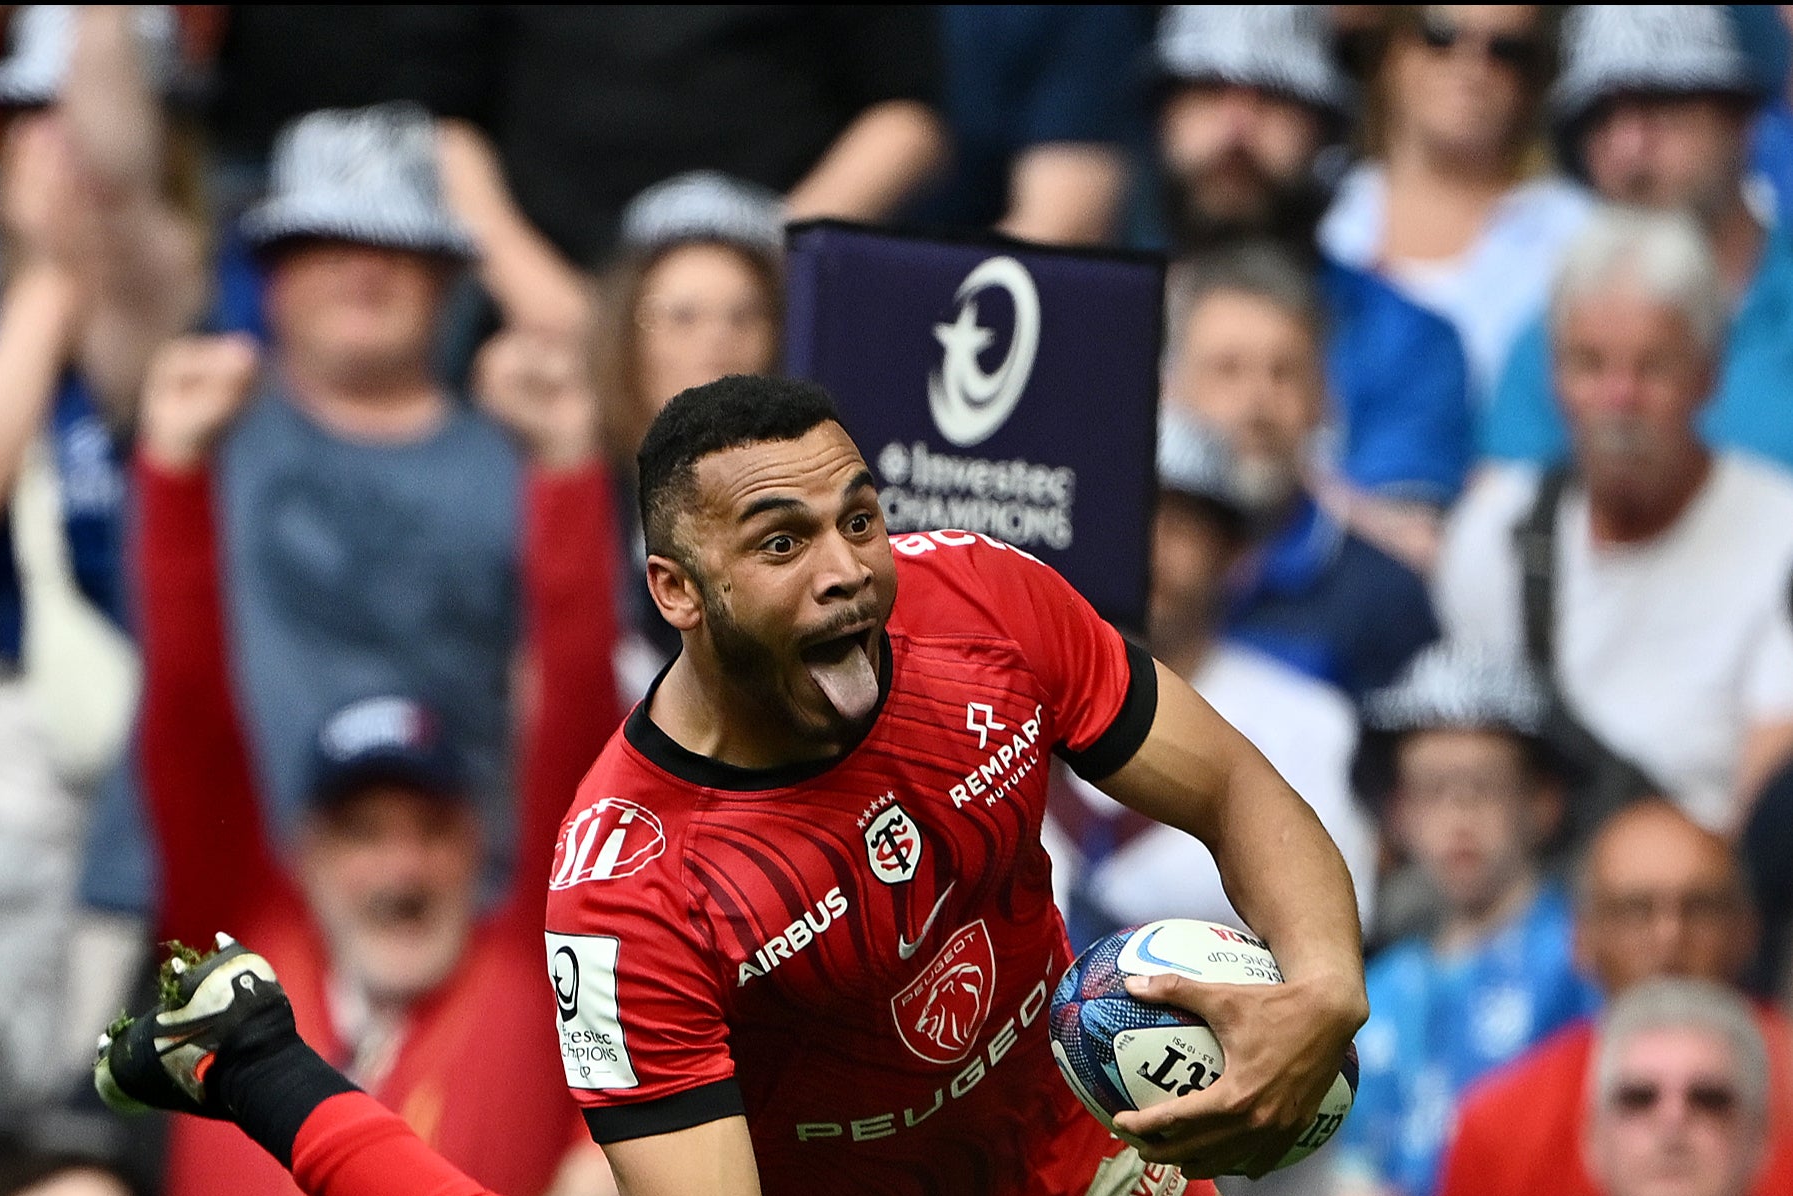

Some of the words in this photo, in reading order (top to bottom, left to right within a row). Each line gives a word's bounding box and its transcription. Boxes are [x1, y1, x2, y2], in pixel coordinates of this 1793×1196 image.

[985, 748, 1039, 808] MUTUELL
[736, 886, 849, 988] AIRBUS
[902, 930, 977, 1007] PEUGEOT
[1207, 951, 1239, 963] CUP
[796, 948, 1055, 1142] PEUGEO
[1171, 1035, 1187, 1050] PSI
